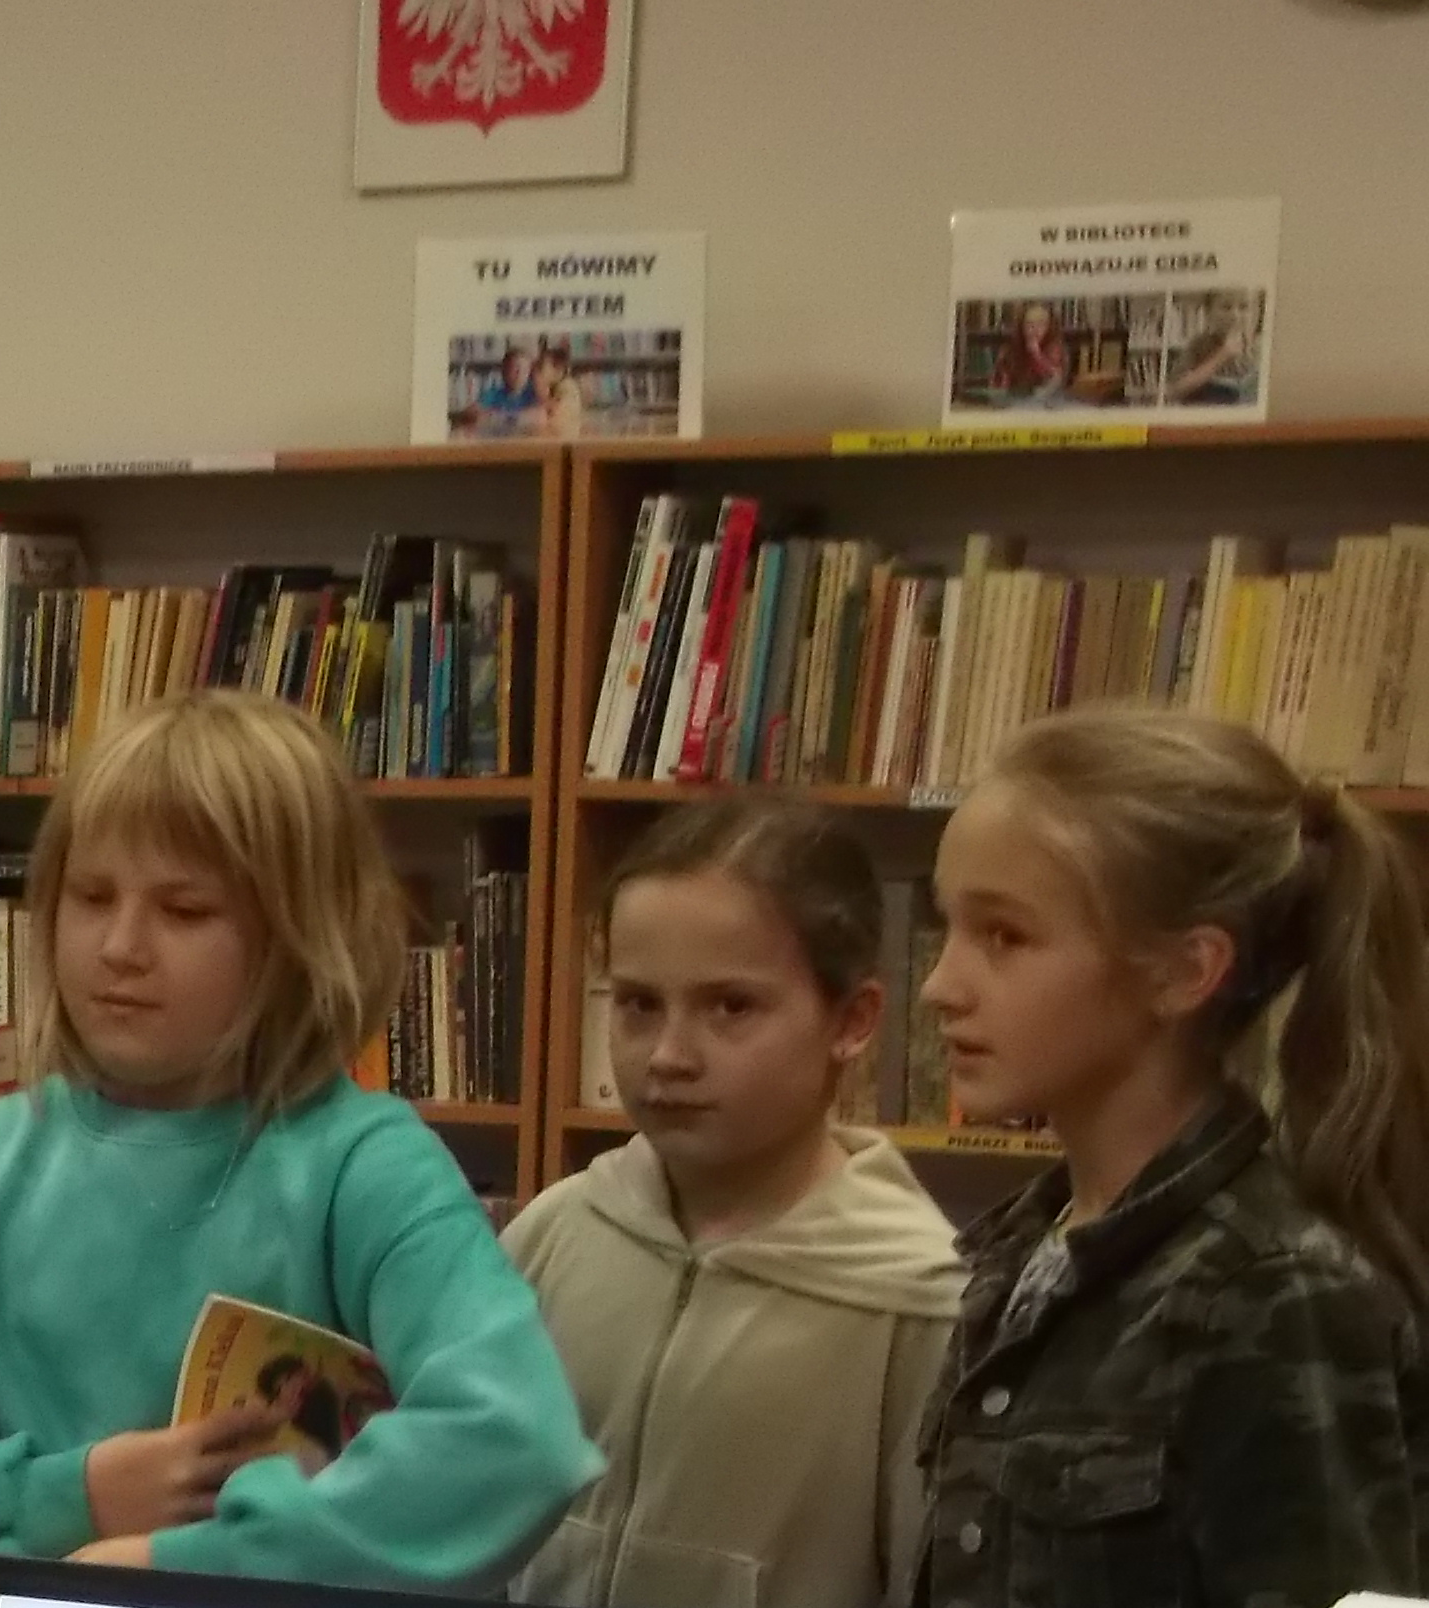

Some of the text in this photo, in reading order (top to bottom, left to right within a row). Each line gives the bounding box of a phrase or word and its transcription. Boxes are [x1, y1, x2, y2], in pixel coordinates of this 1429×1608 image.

[473, 253, 657, 281] TU MÓWIMY
[496, 294, 624, 319] SZEPTEM
